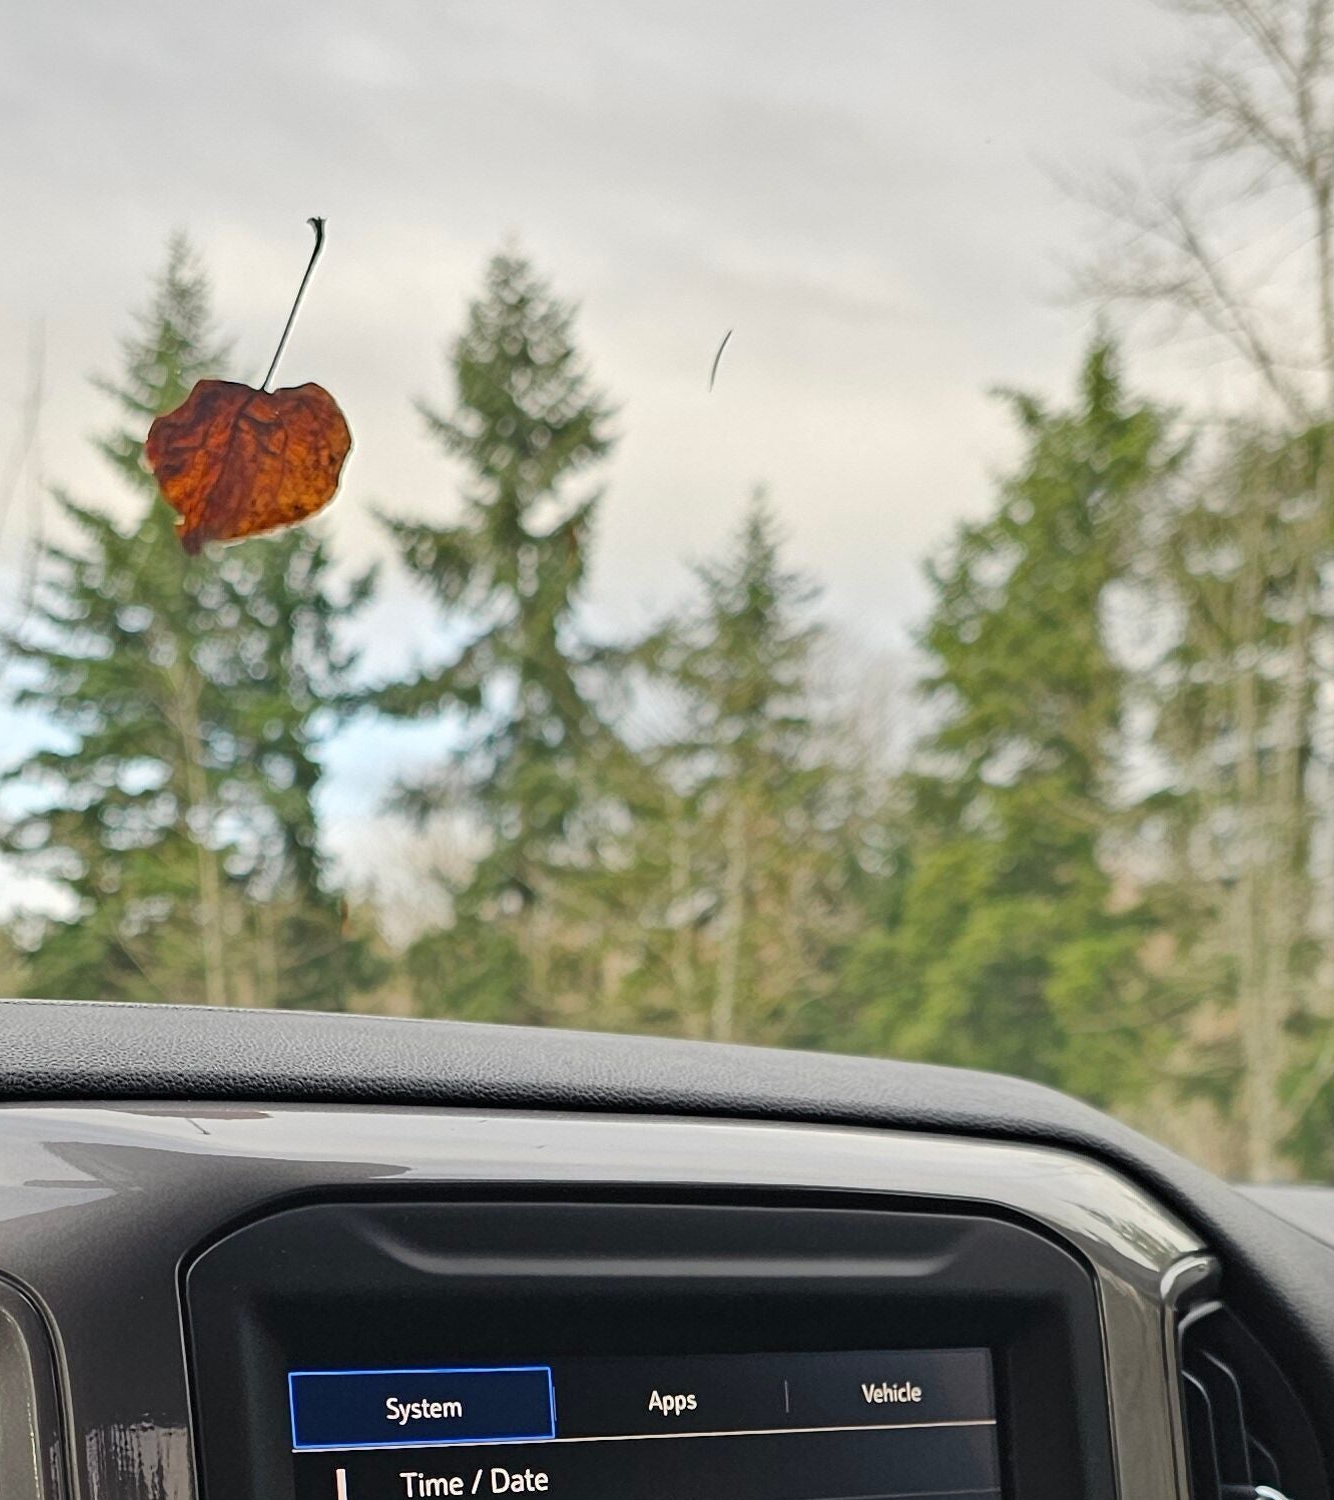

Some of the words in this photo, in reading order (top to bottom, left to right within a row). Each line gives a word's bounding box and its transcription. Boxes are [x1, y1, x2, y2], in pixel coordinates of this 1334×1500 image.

[648, 1390, 698, 1417] Apps
[861, 1381, 922, 1404] Vehicle
[386, 1397, 463, 1426] System
[399, 1471, 465, 1498] Time
[471, 1468, 483, 1495] /
[490, 1467, 549, 1494] Date
